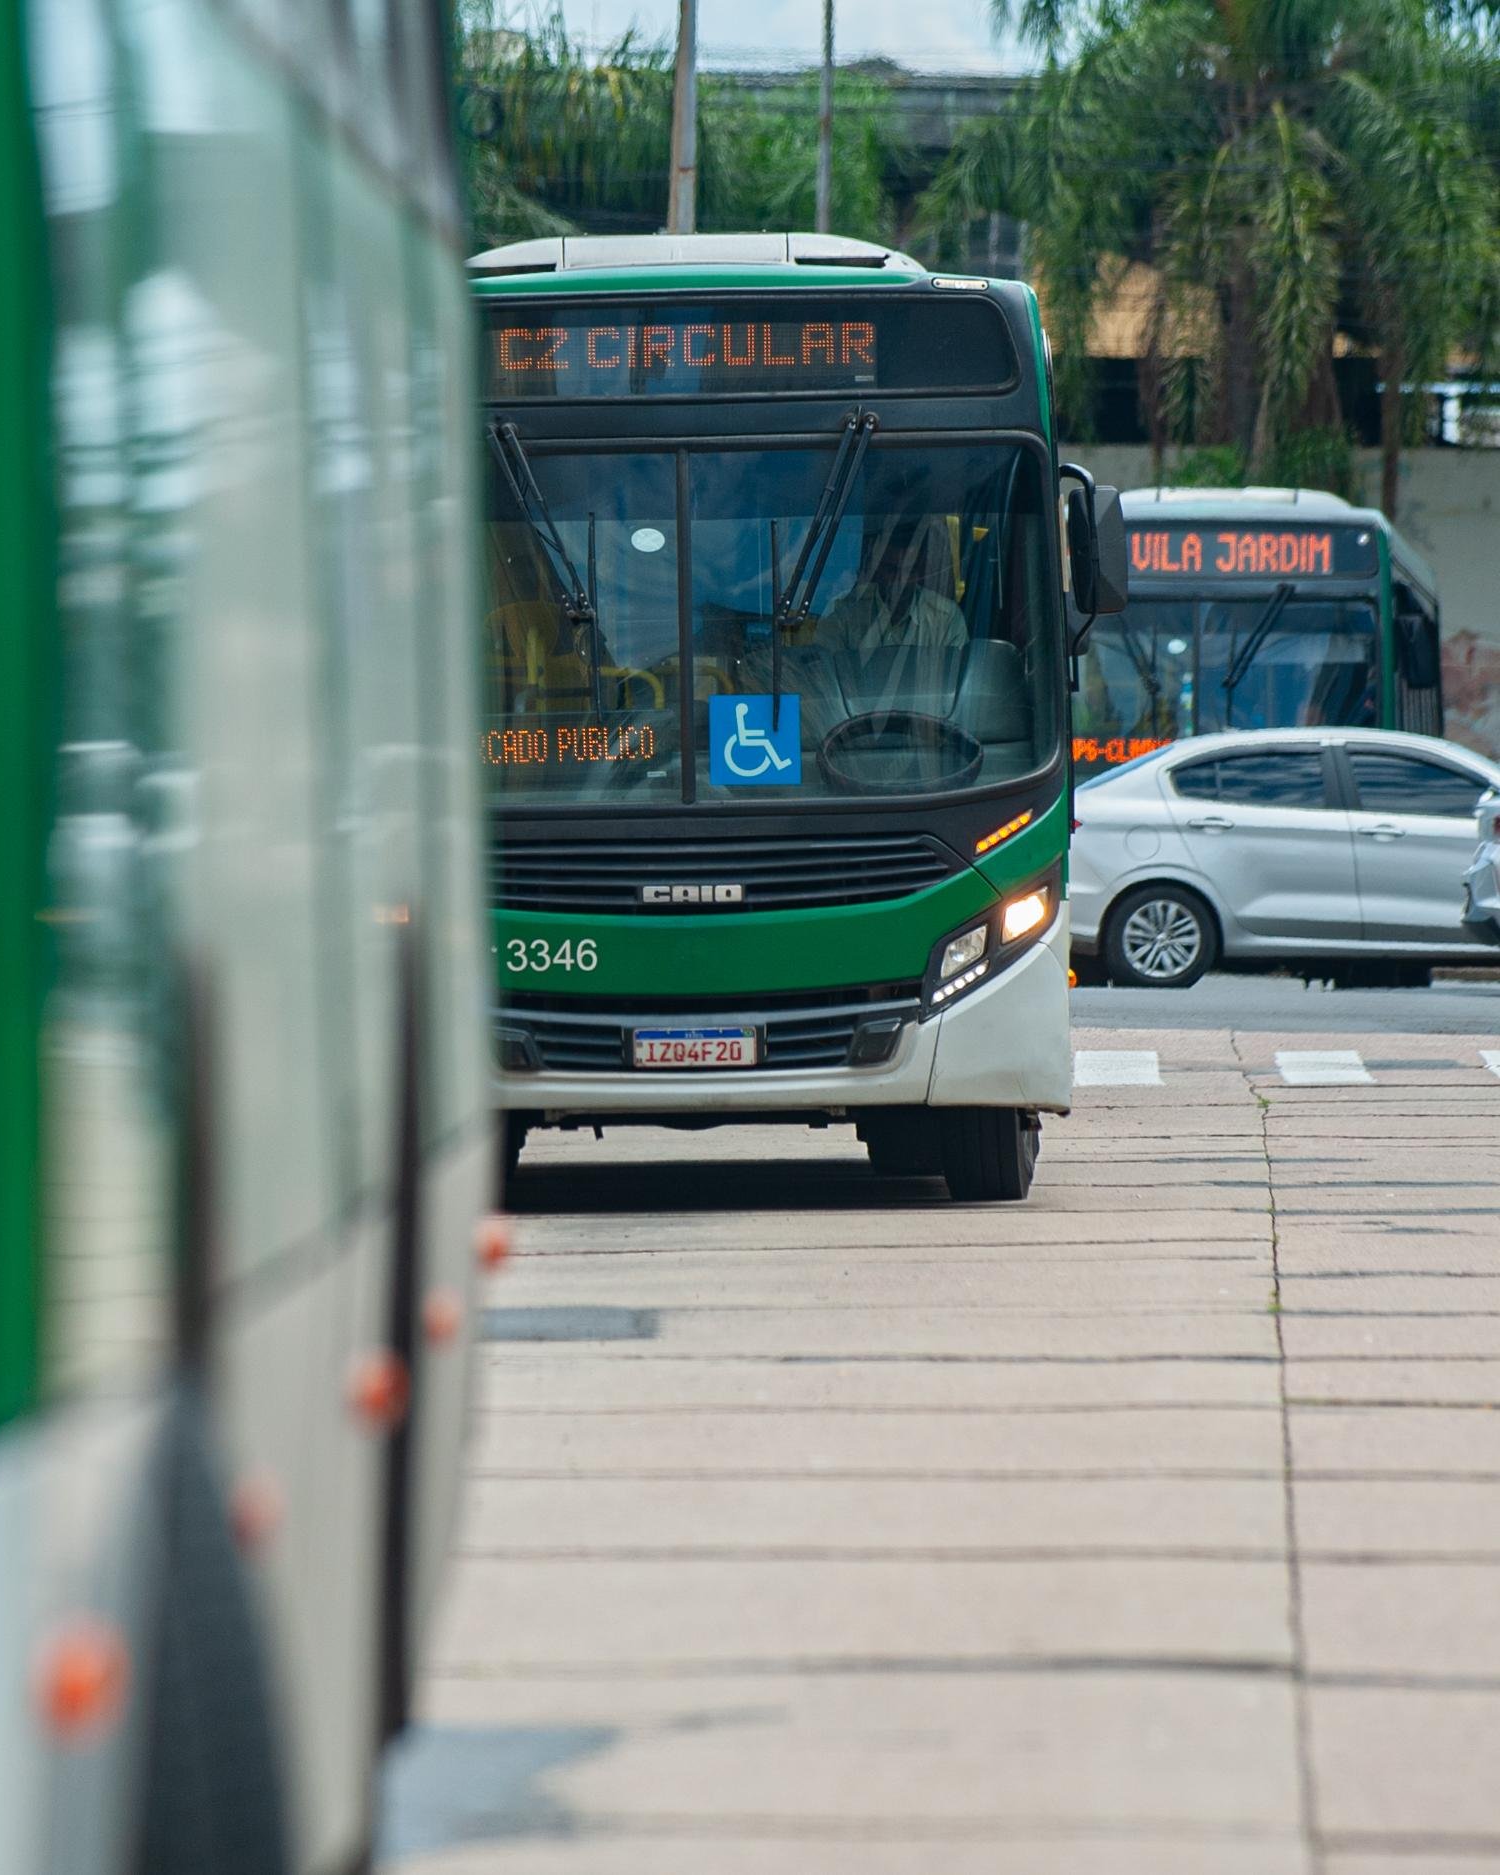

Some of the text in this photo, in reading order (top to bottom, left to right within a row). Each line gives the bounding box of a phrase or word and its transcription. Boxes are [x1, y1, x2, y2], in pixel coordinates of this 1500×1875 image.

[587, 322, 875, 368] CIRCULAR
[1131, 532, 1332, 573] VILA JARDIM
[643, 885, 743, 902] CAIO
[506, 938, 598, 972] 3346
